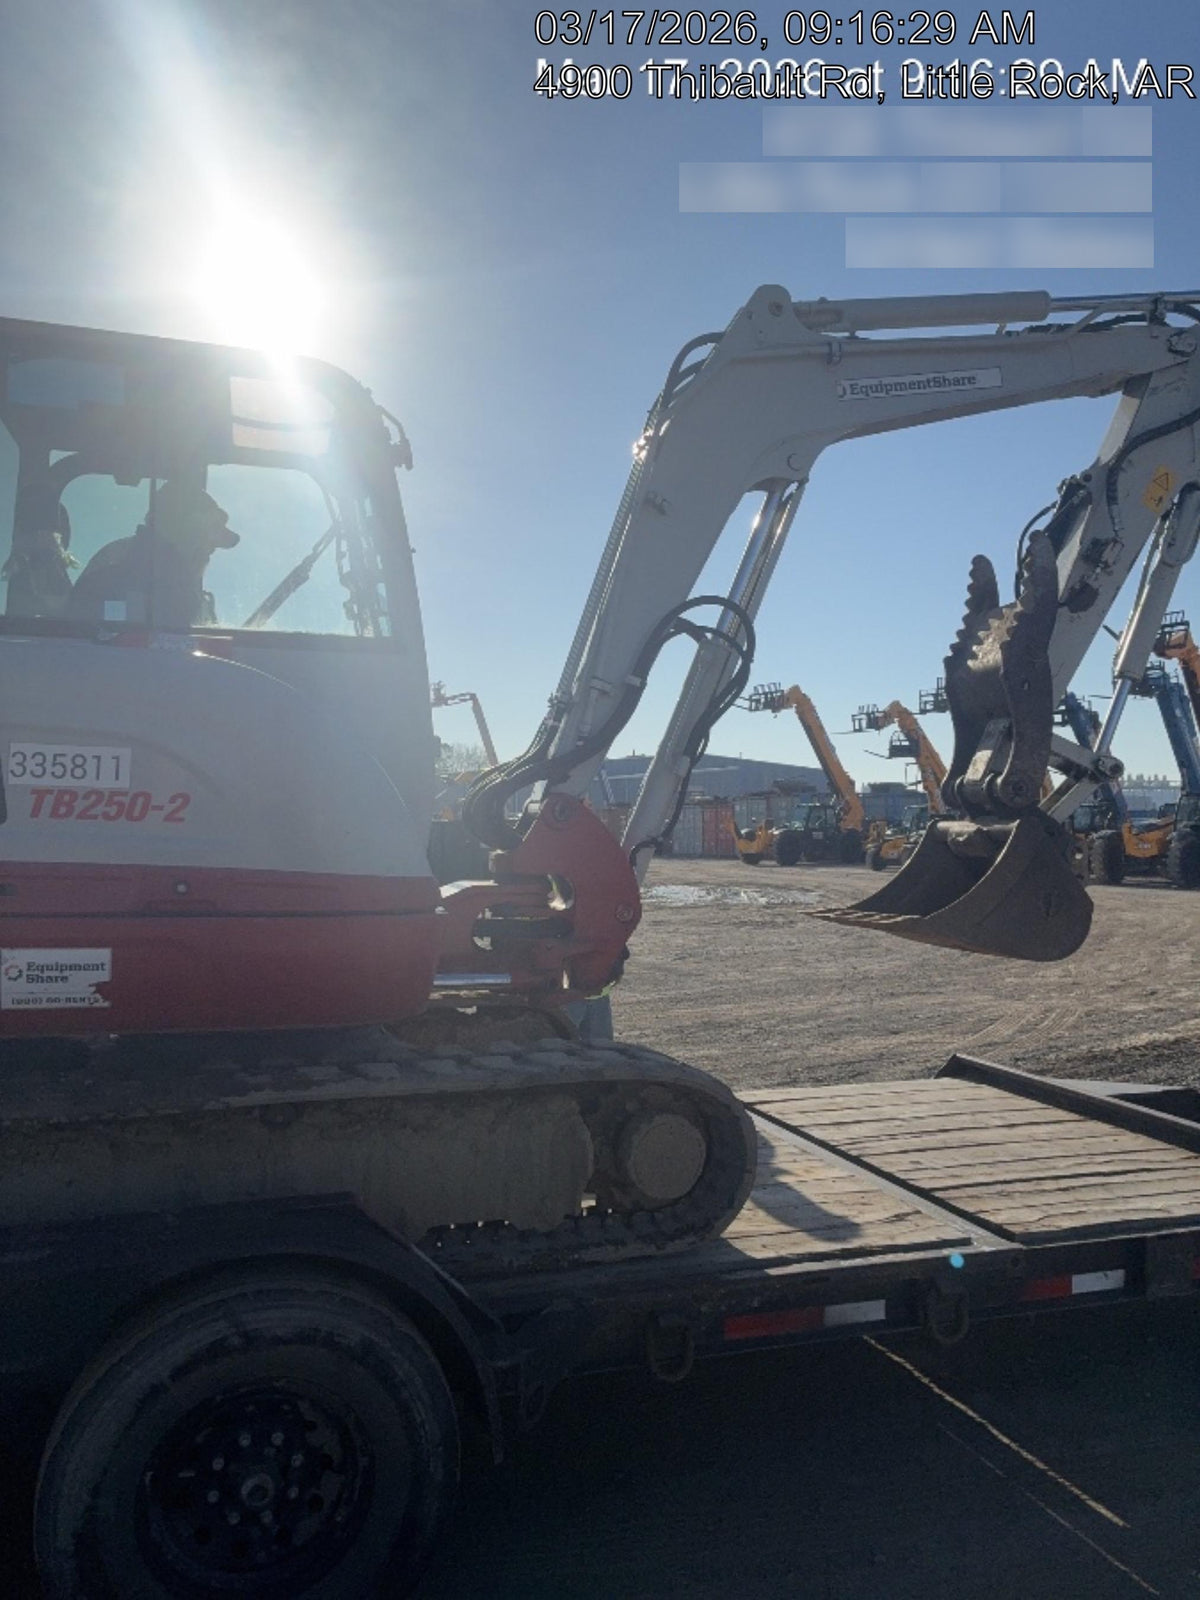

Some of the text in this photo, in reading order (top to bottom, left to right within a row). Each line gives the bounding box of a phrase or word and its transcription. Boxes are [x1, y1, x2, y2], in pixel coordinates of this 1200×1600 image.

[849, 375, 977, 397] EquipmentShare
[9, 751, 121, 781] 335811
[29, 788, 192, 823] TB250-2
[26, 961, 107, 973] Equipment
[26, 973, 69, 983] Share
